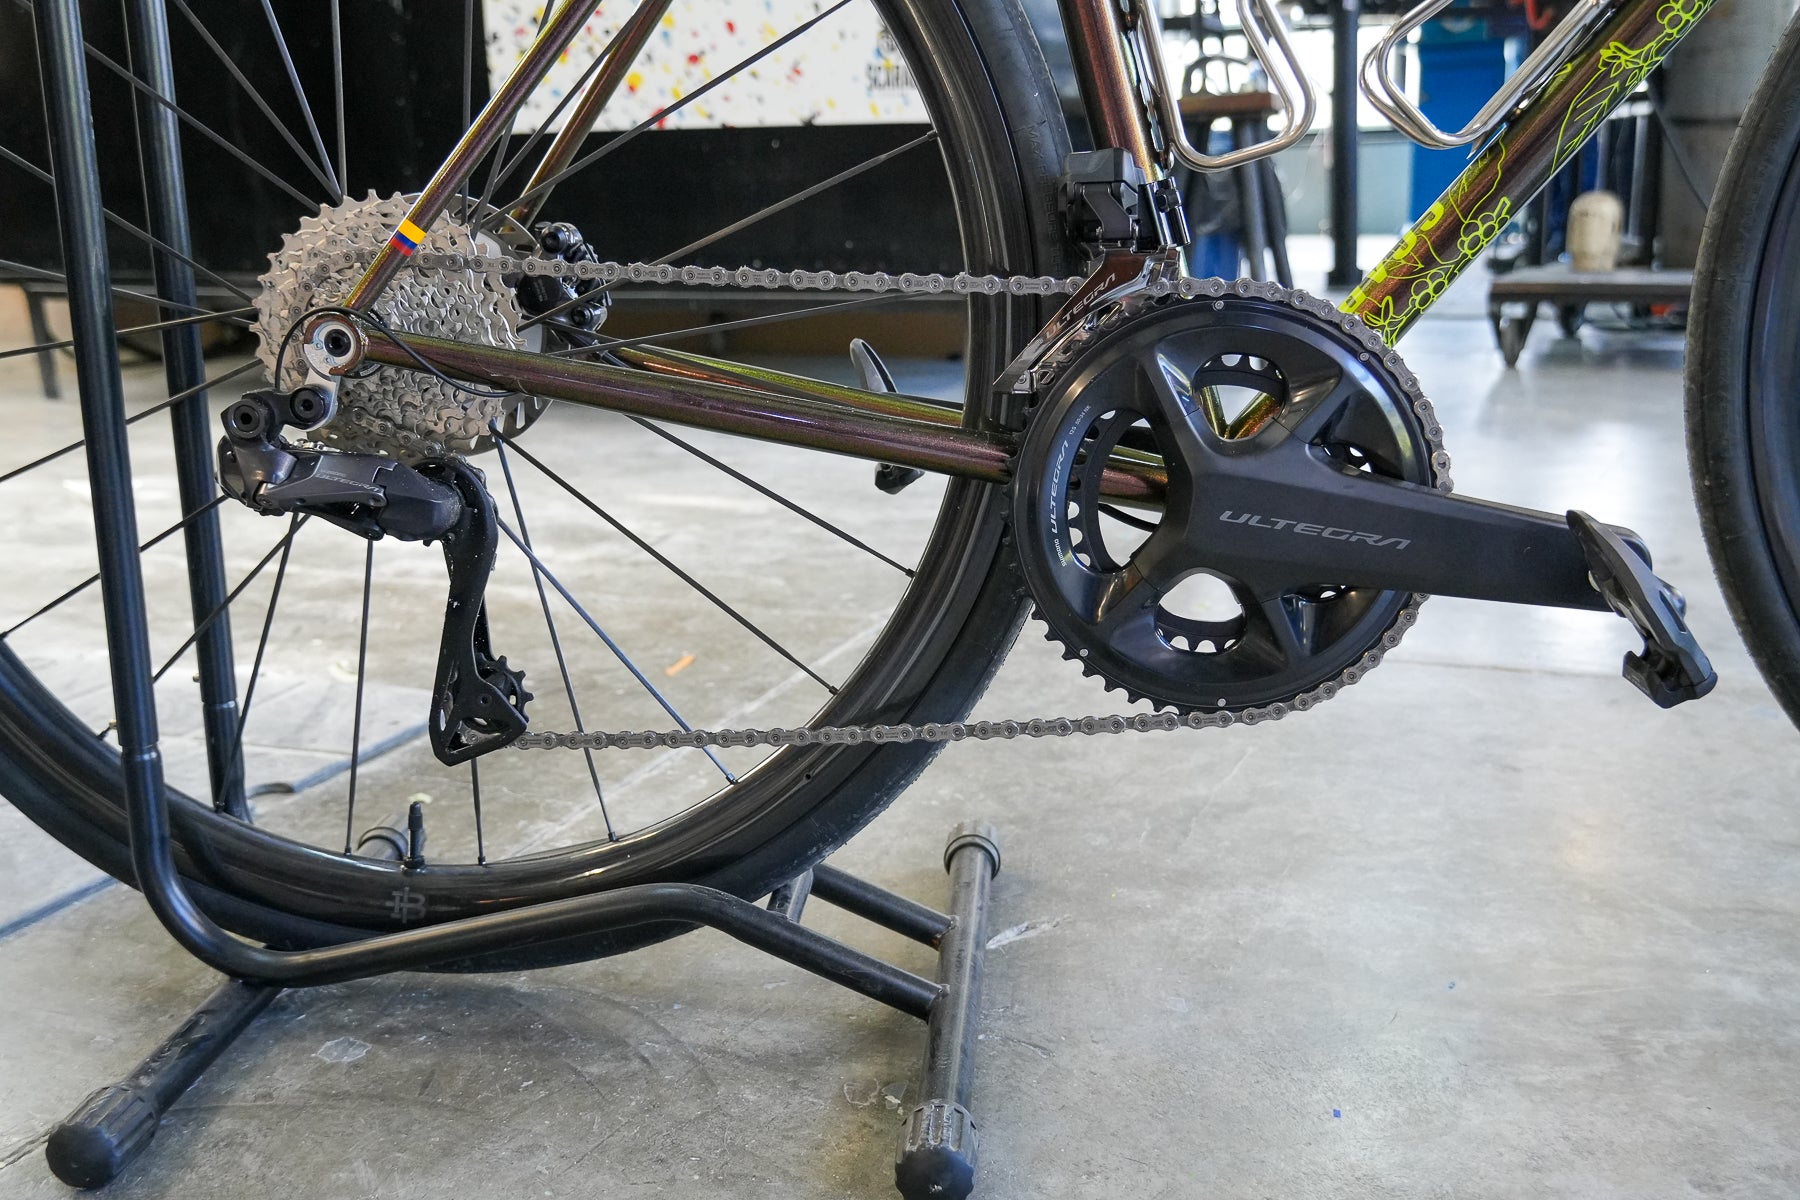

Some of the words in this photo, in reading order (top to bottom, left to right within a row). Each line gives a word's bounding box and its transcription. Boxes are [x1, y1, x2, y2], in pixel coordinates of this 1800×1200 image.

[1045, 272, 1116, 339] ULTEGRA
[314, 473, 380, 492] ULTEGRA
[1050, 440, 1069, 534] ULTEGRA
[1219, 510, 1412, 550] ULTEGRA
[1054, 538, 1068, 568] SHIMANO
